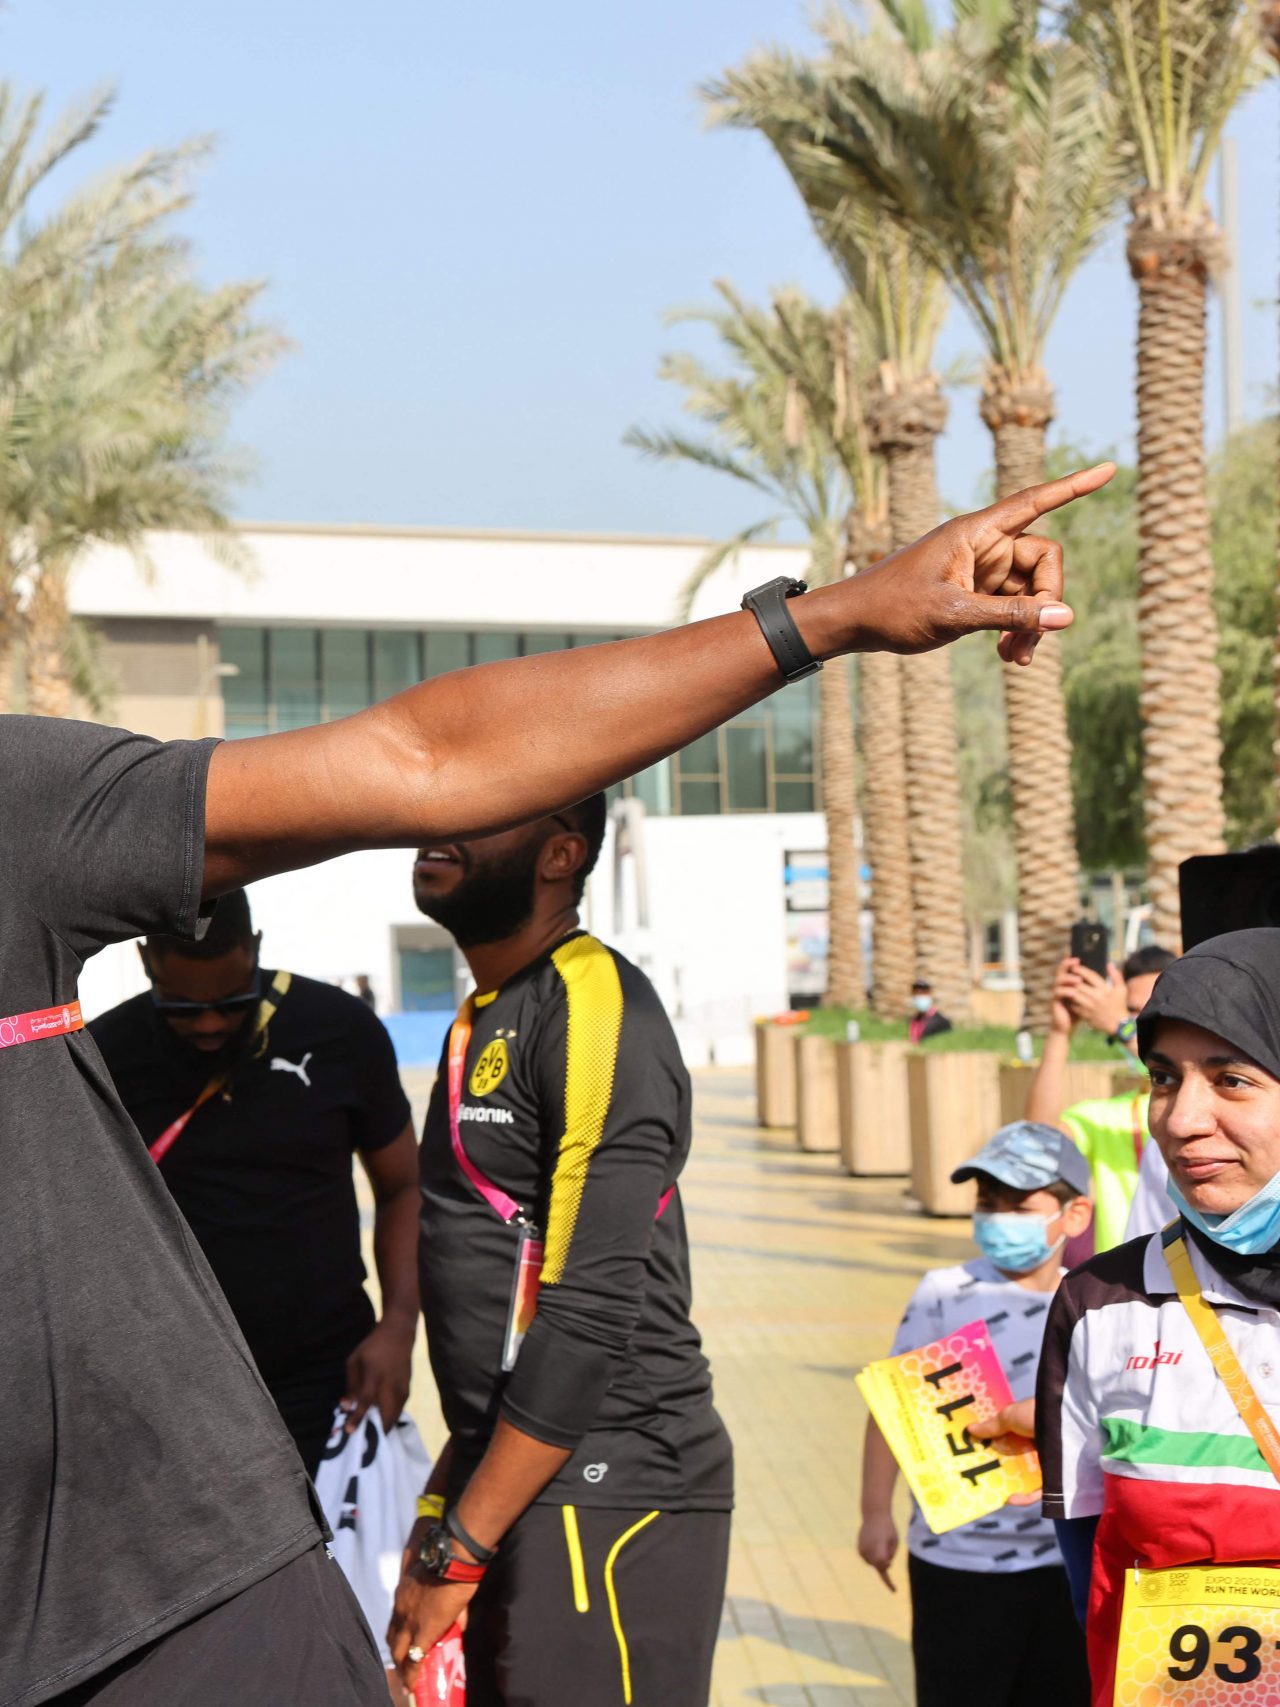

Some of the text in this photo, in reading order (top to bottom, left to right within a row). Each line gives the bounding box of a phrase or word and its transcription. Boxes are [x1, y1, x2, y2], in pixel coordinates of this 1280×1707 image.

[476, 1047, 504, 1078] BVB
[923, 1361, 1001, 1487] 1511
[1169, 1572, 1190, 1580] EXPO
[1205, 1576, 1233, 1585] EXPO
[1235, 1577, 1261, 1586] 2020
[1205, 1586, 1226, 1594] RUN
[1228, 1586, 1248, 1595] THE
